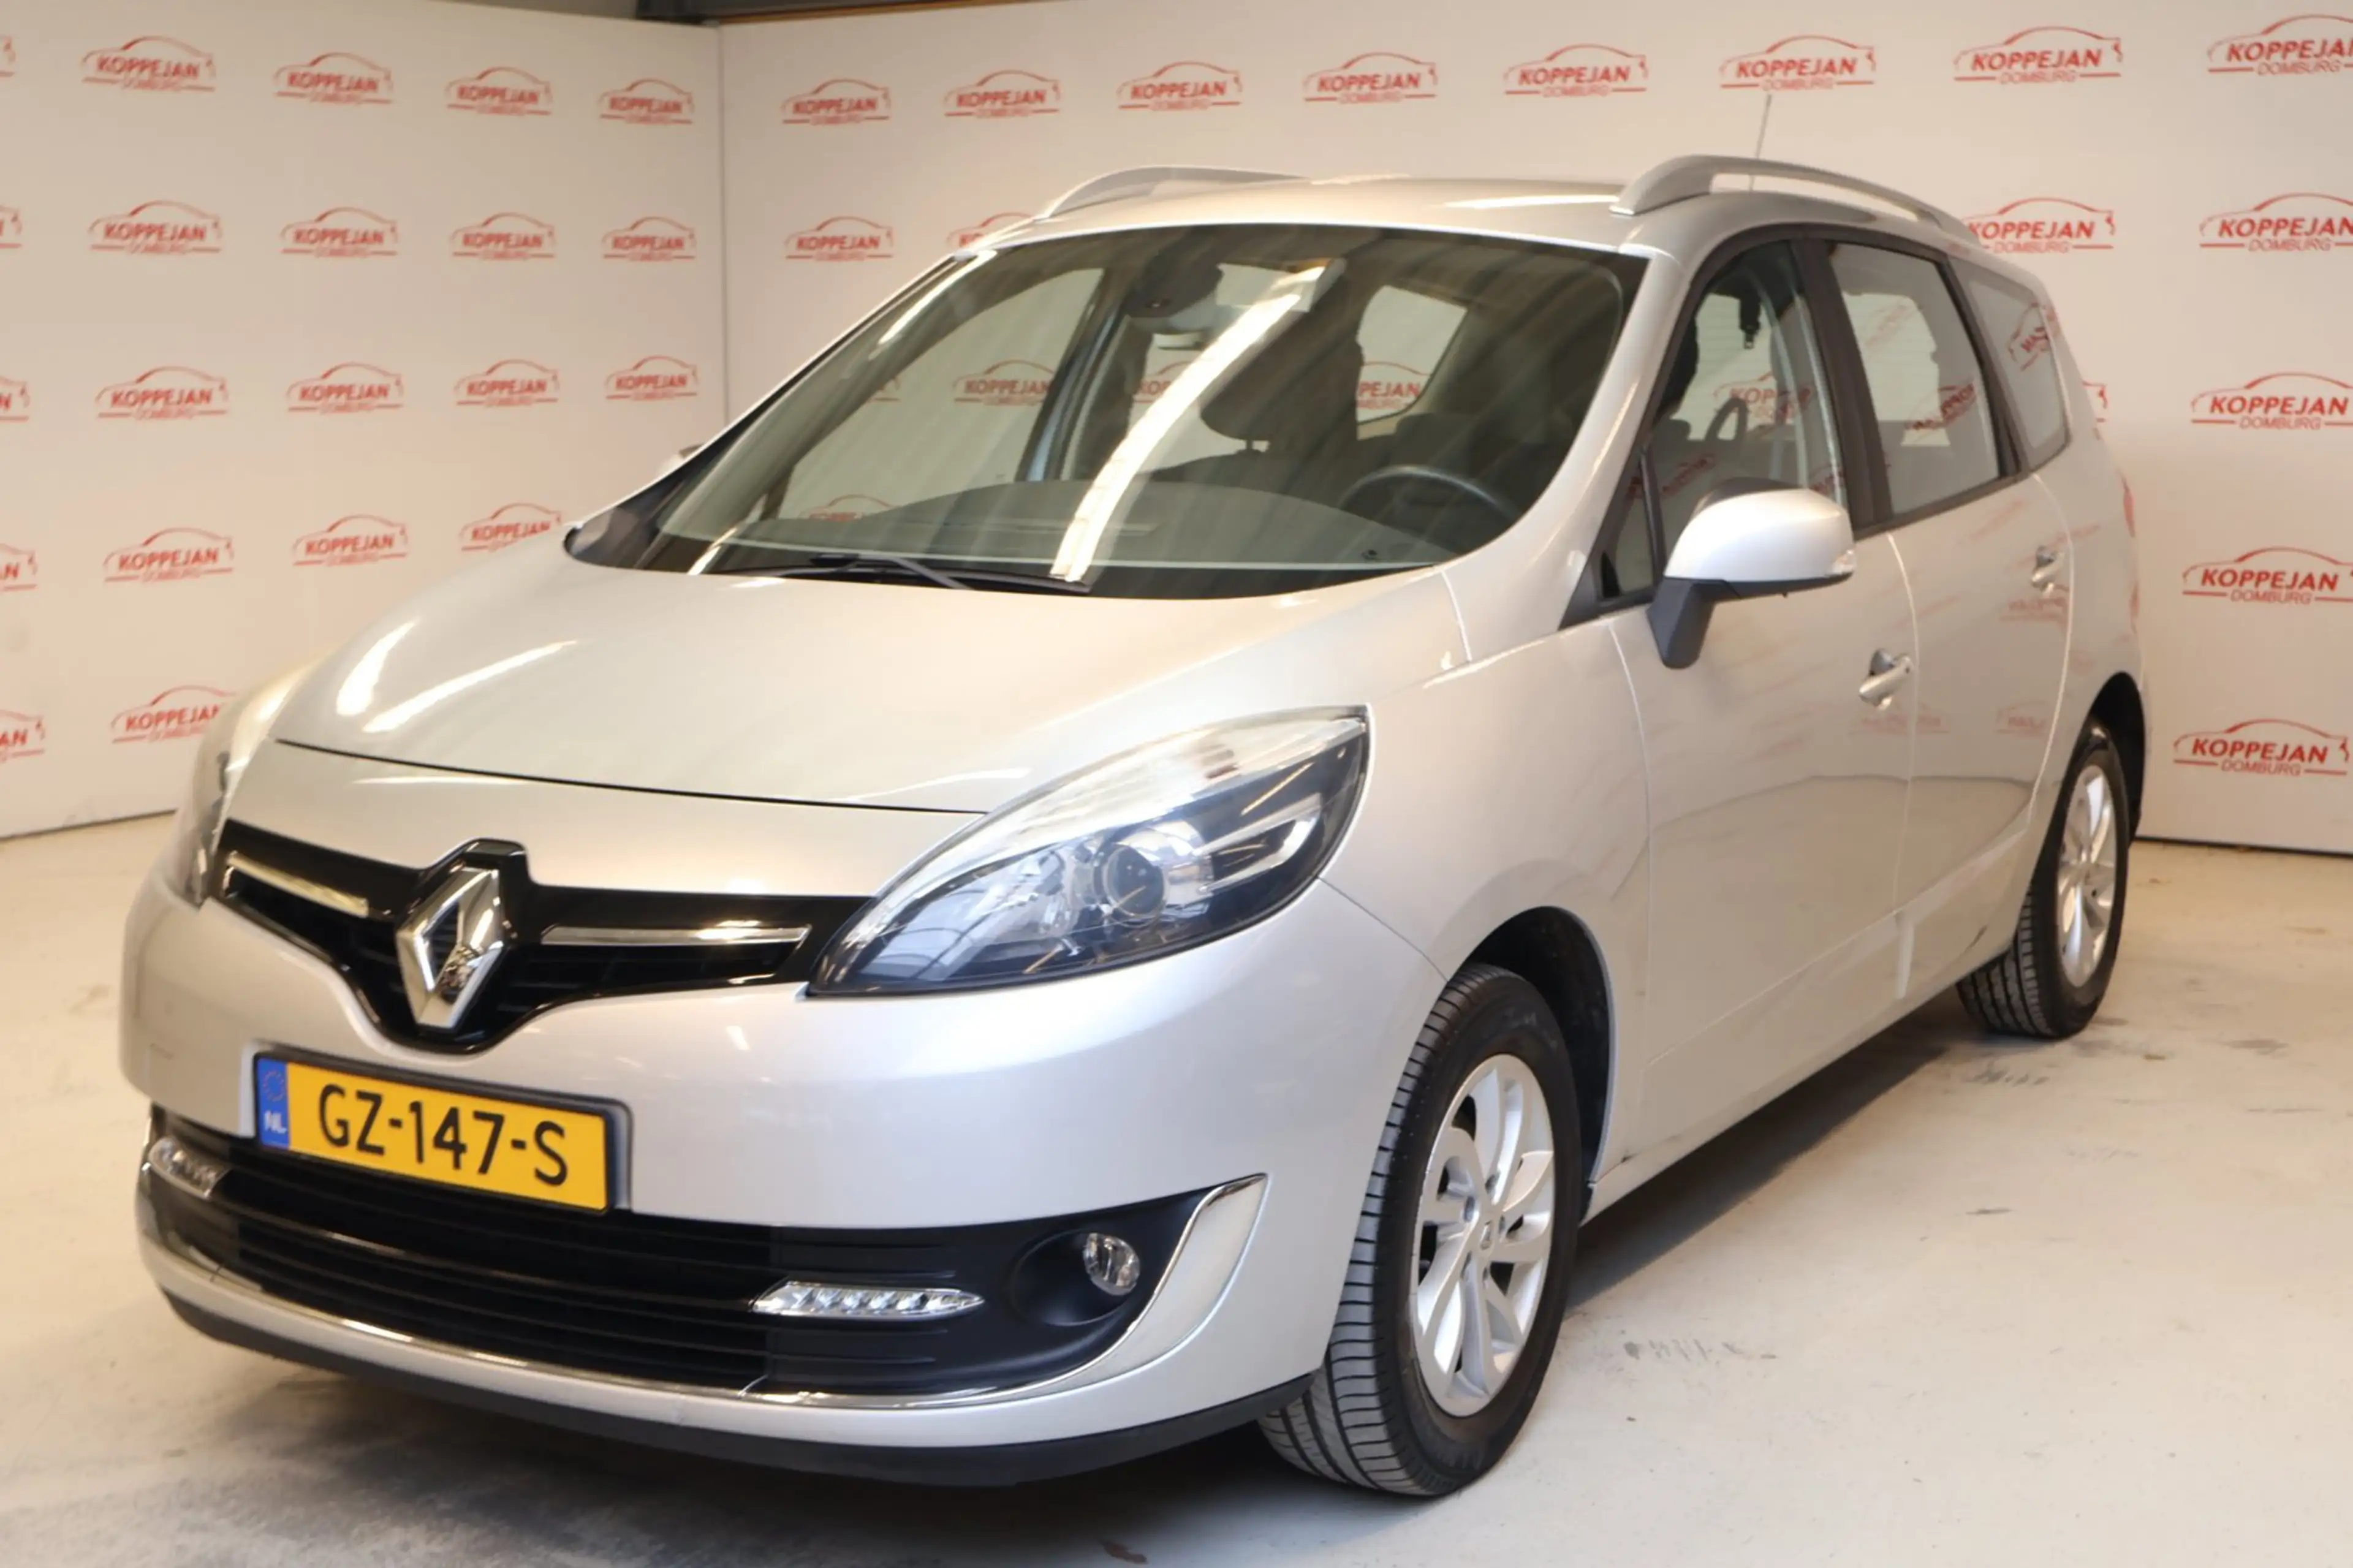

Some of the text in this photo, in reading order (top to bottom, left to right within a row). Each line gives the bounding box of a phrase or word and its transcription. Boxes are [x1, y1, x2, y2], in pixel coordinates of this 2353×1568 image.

[1971, 48, 2103, 70] KOPPEJAN
[2227, 38, 2353, 61] KOPPEJA
[97, 57, 199, 78] KOPPEJAN
[1518, 66, 1631, 86] KOPPEJAN
[1735, 57, 1858, 78] KOPPEJAN
[2257, 59, 2341, 76] DOMBURG
[287, 72, 378, 93] KOPPEJAN
[1131, 80, 1227, 99] KOPPEJAN
[1316, 72, 1421, 93] KOPPEJAN
[457, 85, 538, 104] KOPPEJAN
[957, 89, 1046, 108] KOPPEJAN
[608, 96, 683, 113] KOPPEJAN
[792, 98, 877, 114] KOPPEJAN
[104, 223, 207, 240] KOPPEJAN
[293, 229, 384, 245] KOPPEJAN
[462, 232, 543, 248] KOPPEJAN
[613, 236, 684, 250] KOPPEJAN
[796, 235, 881, 249] KOPPEJAN
[2248, 238, 2332, 252] DOMBURG
[298, 383, 391, 401] KOPPEJAN
[466, 379, 547, 395] KOPPEJAN
[614, 375, 688, 390] KOPPEJAN
[111, 388, 213, 408] KOPPEJAN
[2210, 395, 2349, 415] KOPPEJAN
[2240, 417, 2321, 430] DOMBURG
[306, 533, 395, 553] KOPPEJAN
[118, 547, 219, 571] KOPPEJAN
[2200, 569, 2340, 592] KOPPEJAN
[2230, 589, 2312, 605] DOMBURG
[2191, 738, 2328, 764] KOPPEJAN
[2220, 759, 2302, 776] DOMBURG
[263, 1110, 287, 1134] NL
[319, 1083, 567, 1186] GZ-147-S
